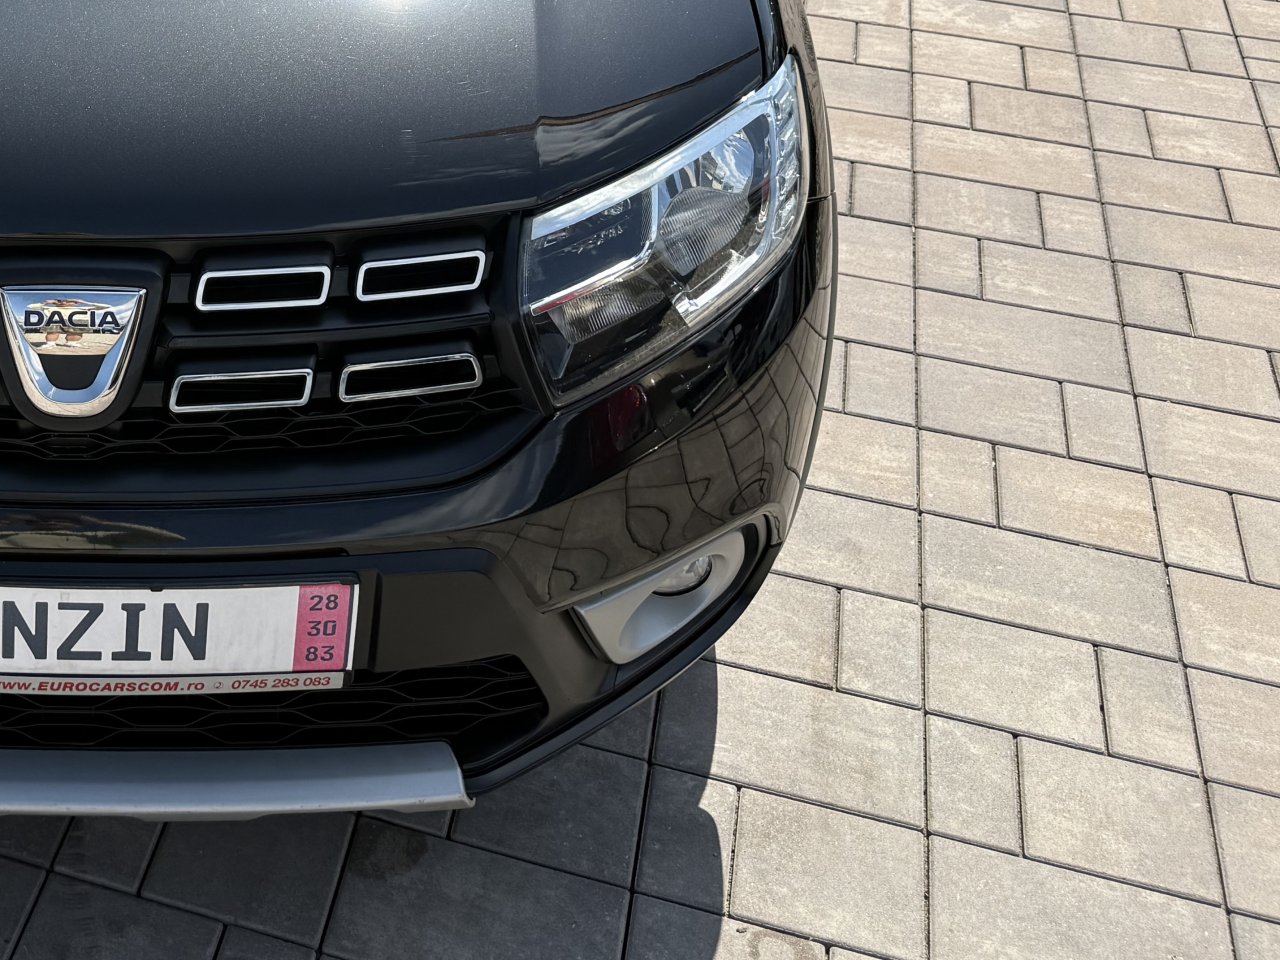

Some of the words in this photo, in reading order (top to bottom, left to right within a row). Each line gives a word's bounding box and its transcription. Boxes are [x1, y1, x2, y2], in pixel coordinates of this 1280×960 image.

[23, 310, 121, 328] DACIA
[308, 593, 339, 612] 28
[306, 620, 337, 637] 30
[304, 644, 335, 662] 83
[231, 678, 268, 690] 0745
[271, 676, 299, 688] 283
[303, 676, 331, 687] 083
